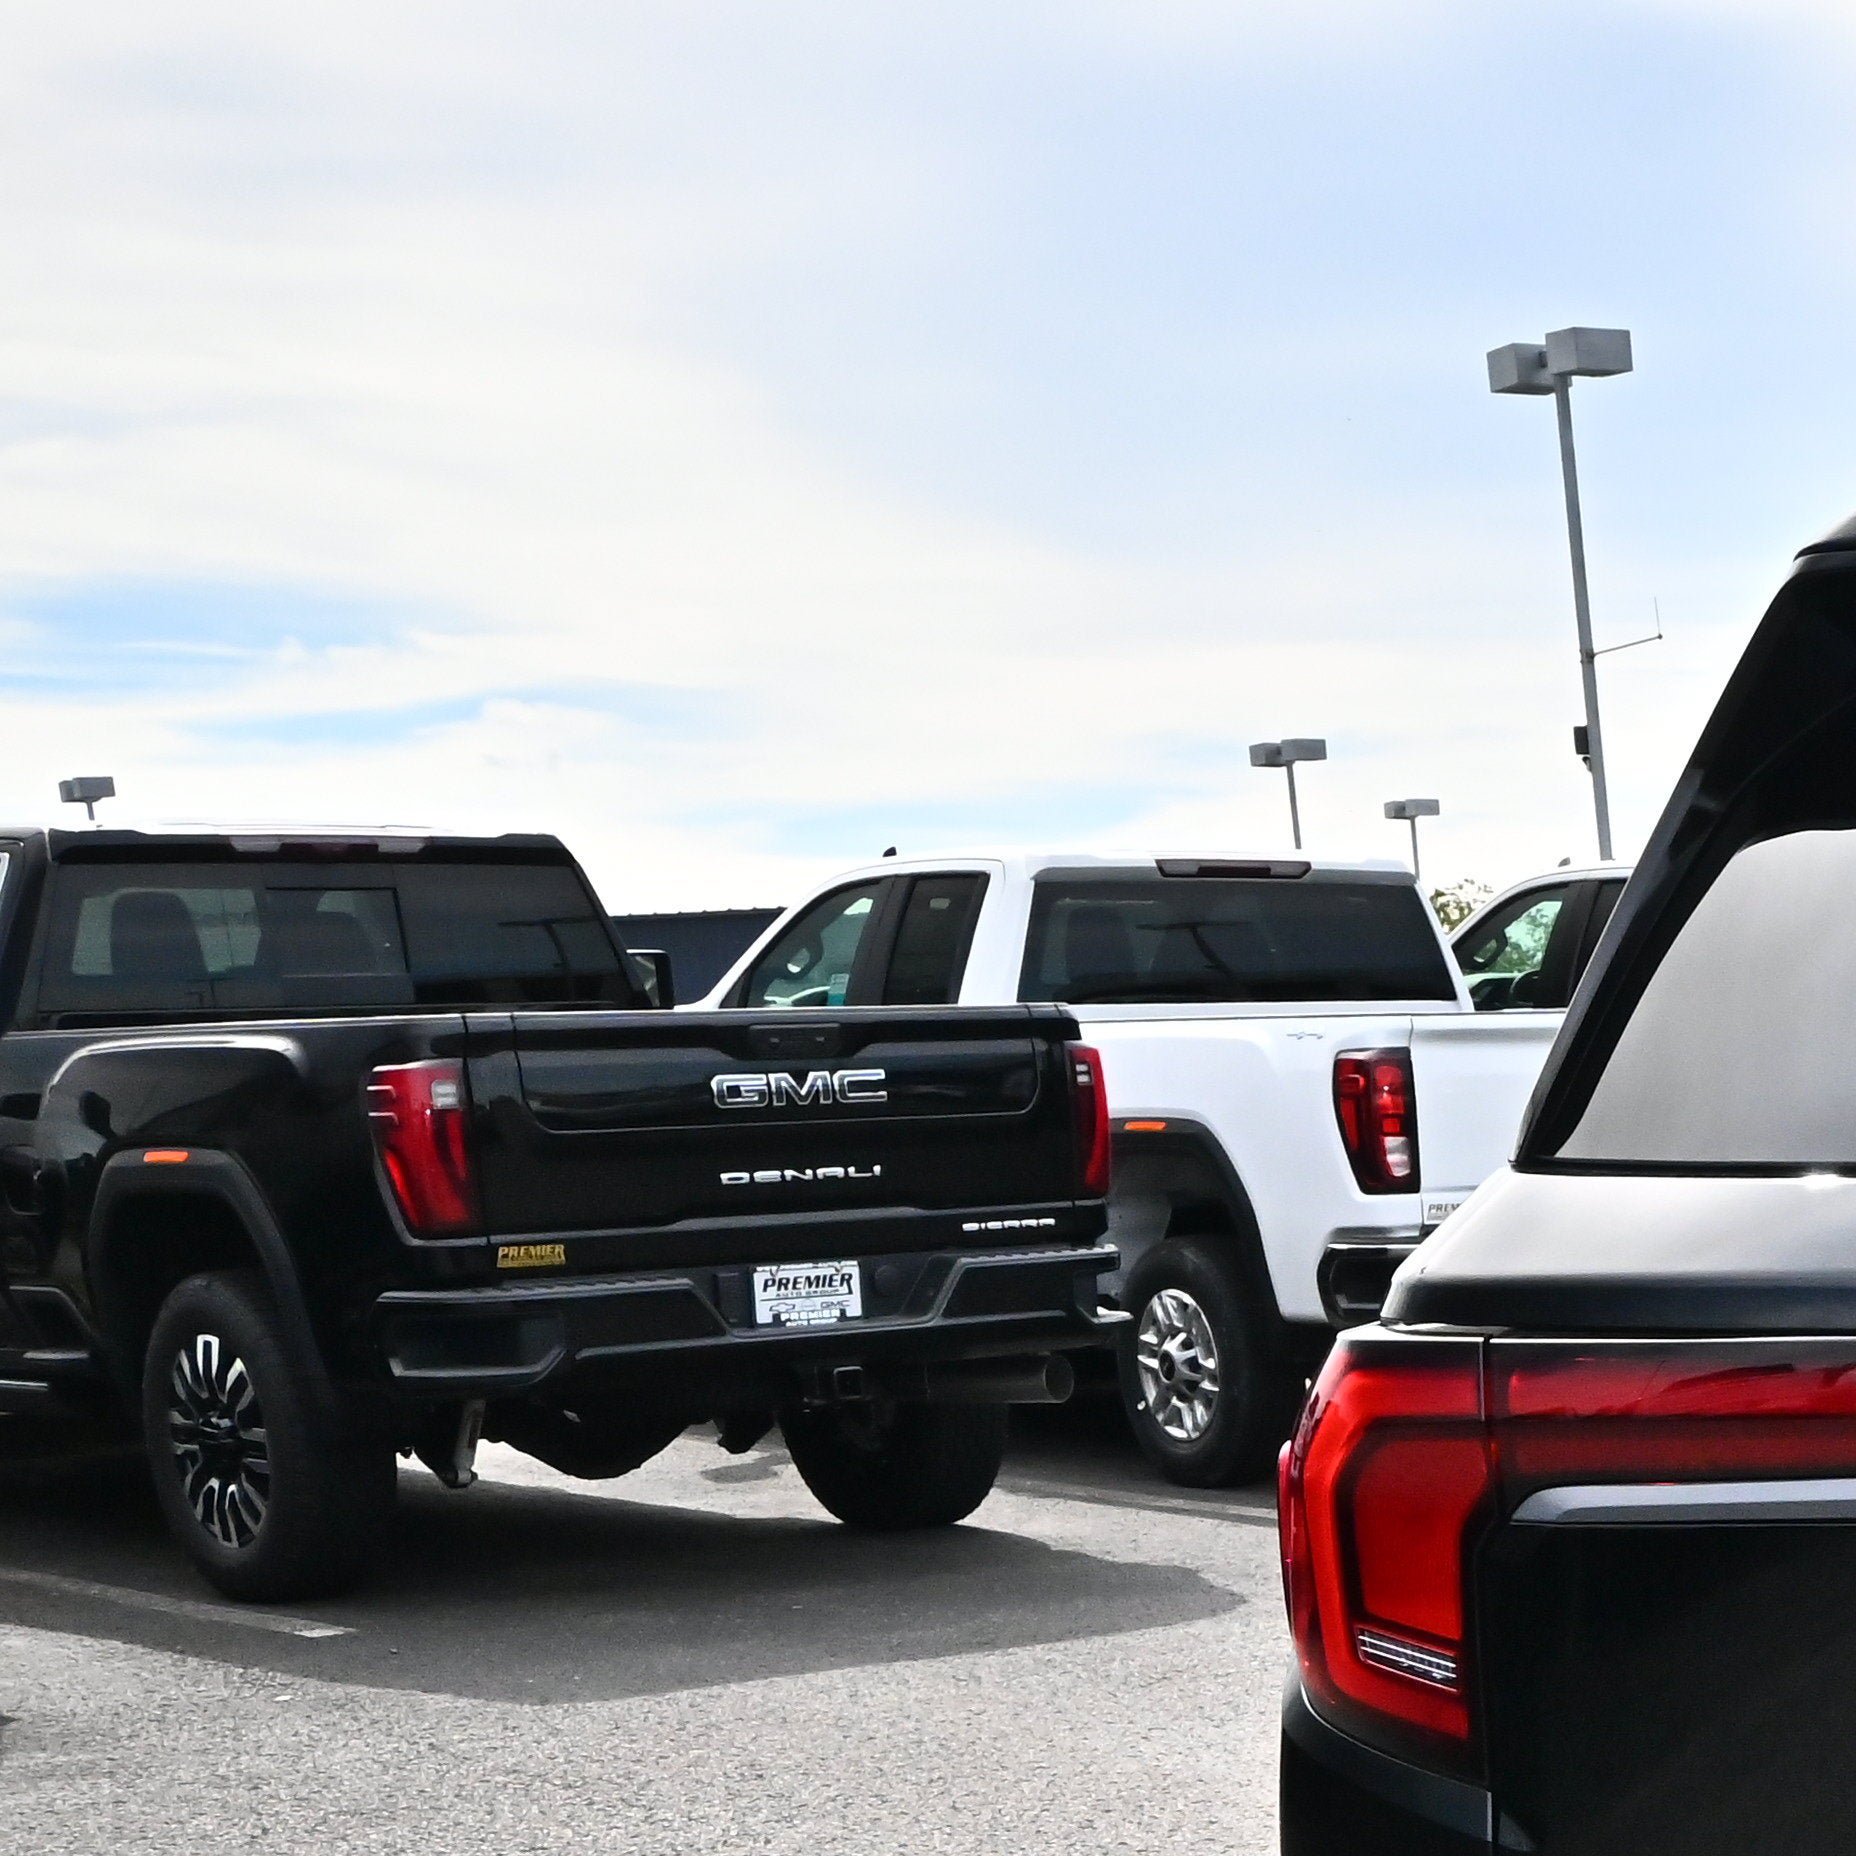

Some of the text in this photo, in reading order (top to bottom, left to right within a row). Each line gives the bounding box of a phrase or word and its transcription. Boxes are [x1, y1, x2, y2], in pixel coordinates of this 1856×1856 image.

[710, 1068, 888, 1109] GMC
[720, 1164, 881, 1185] DENALI
[762, 1273, 853, 1295] PREMIER
[820, 1300, 850, 1309] GMC
